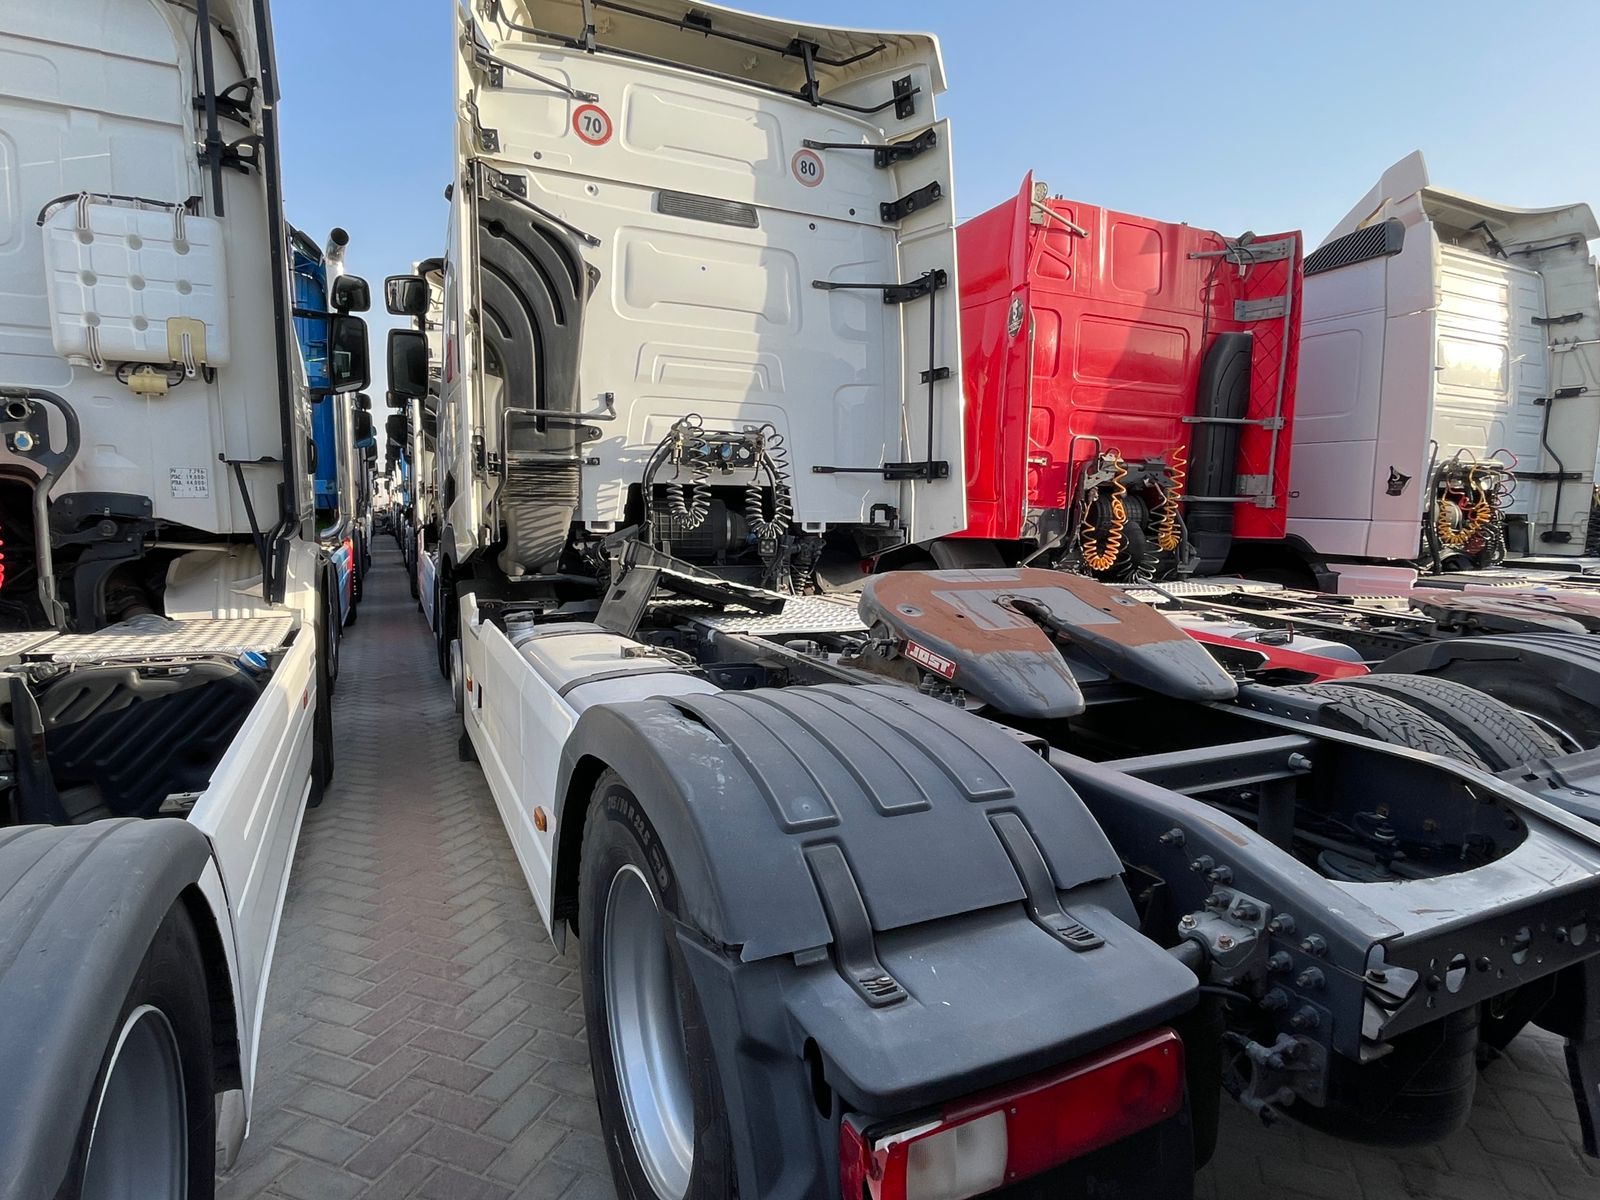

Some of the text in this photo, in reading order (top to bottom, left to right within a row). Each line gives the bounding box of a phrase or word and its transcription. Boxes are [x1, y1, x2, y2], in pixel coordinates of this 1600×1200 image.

[583, 115, 602, 134] 70
[800, 160, 816, 177] 80
[909, 645, 951, 673] JOST
